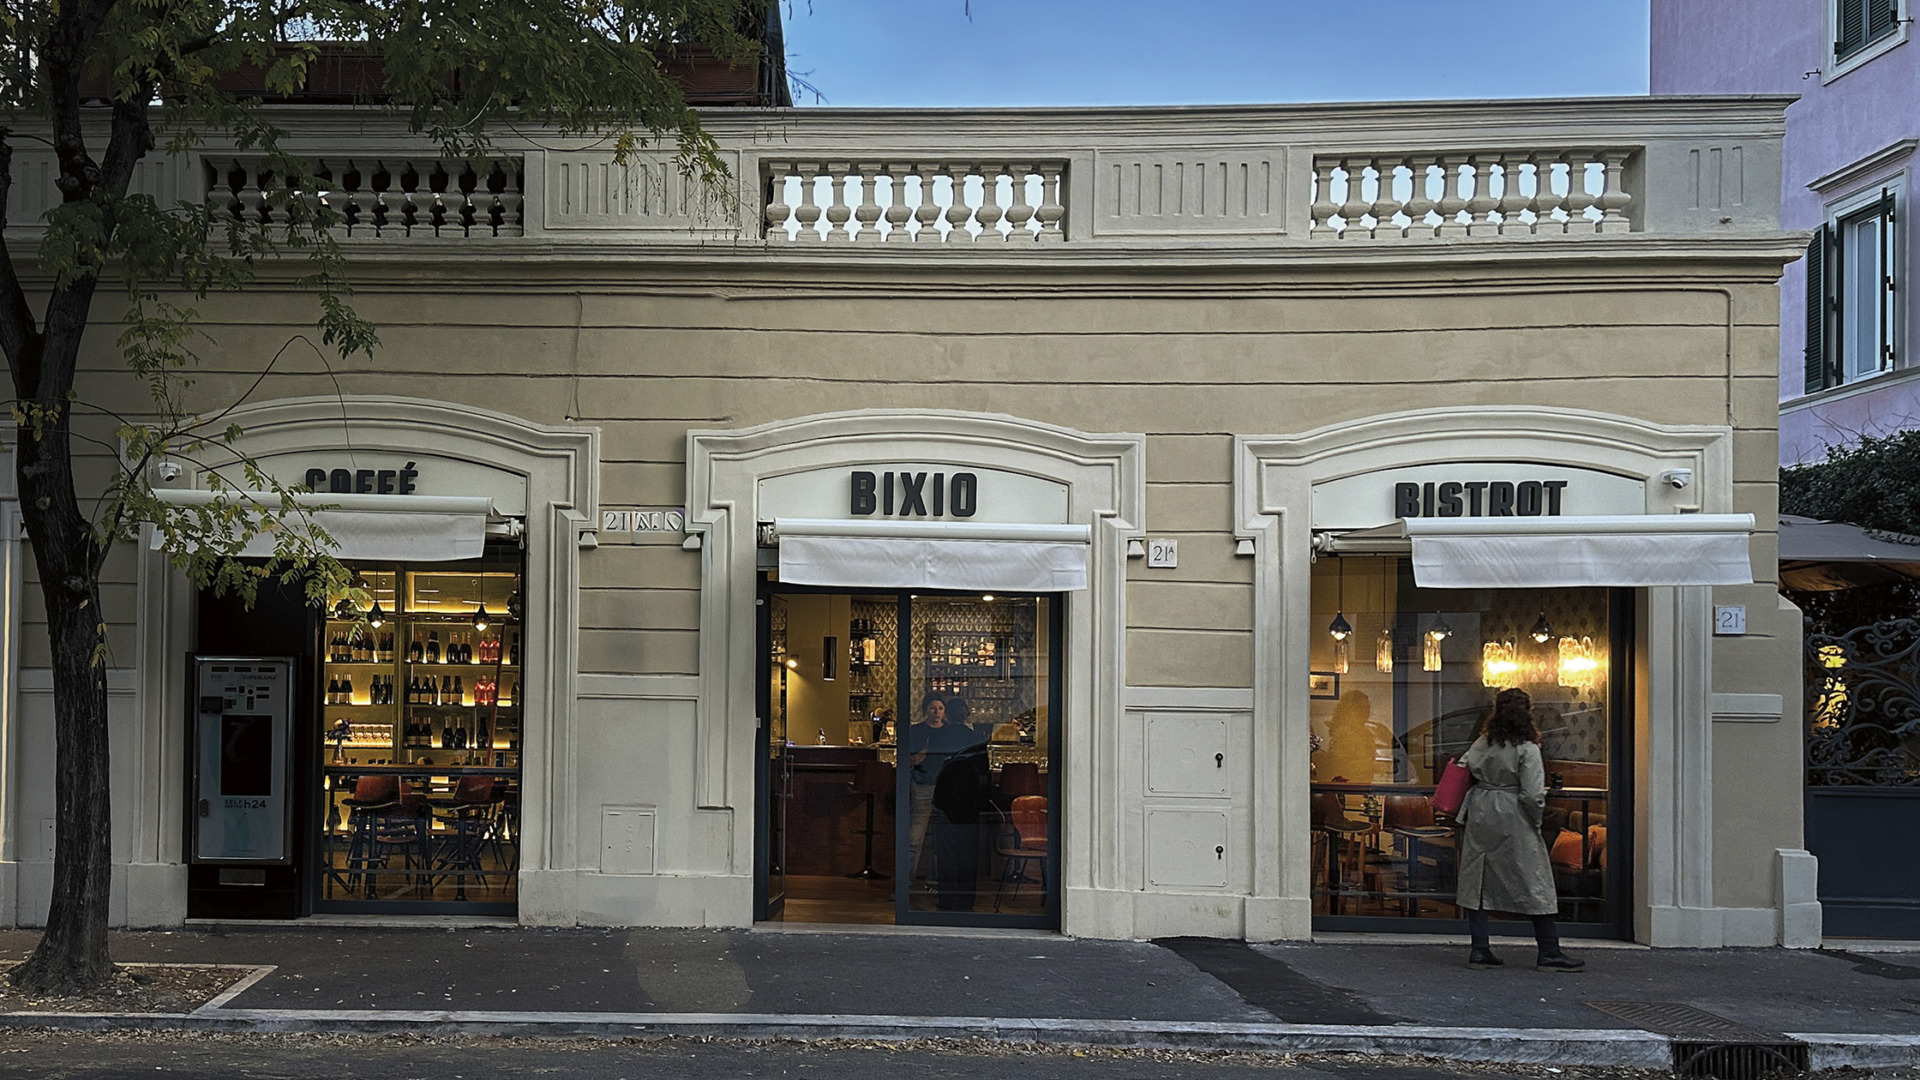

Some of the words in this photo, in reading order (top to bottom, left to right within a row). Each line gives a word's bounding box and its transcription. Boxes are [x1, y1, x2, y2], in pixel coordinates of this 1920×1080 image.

[850, 471, 977, 517] BIXIO
[1395, 481, 1568, 518] BISTROT
[1721, 611, 1739, 628] 21
